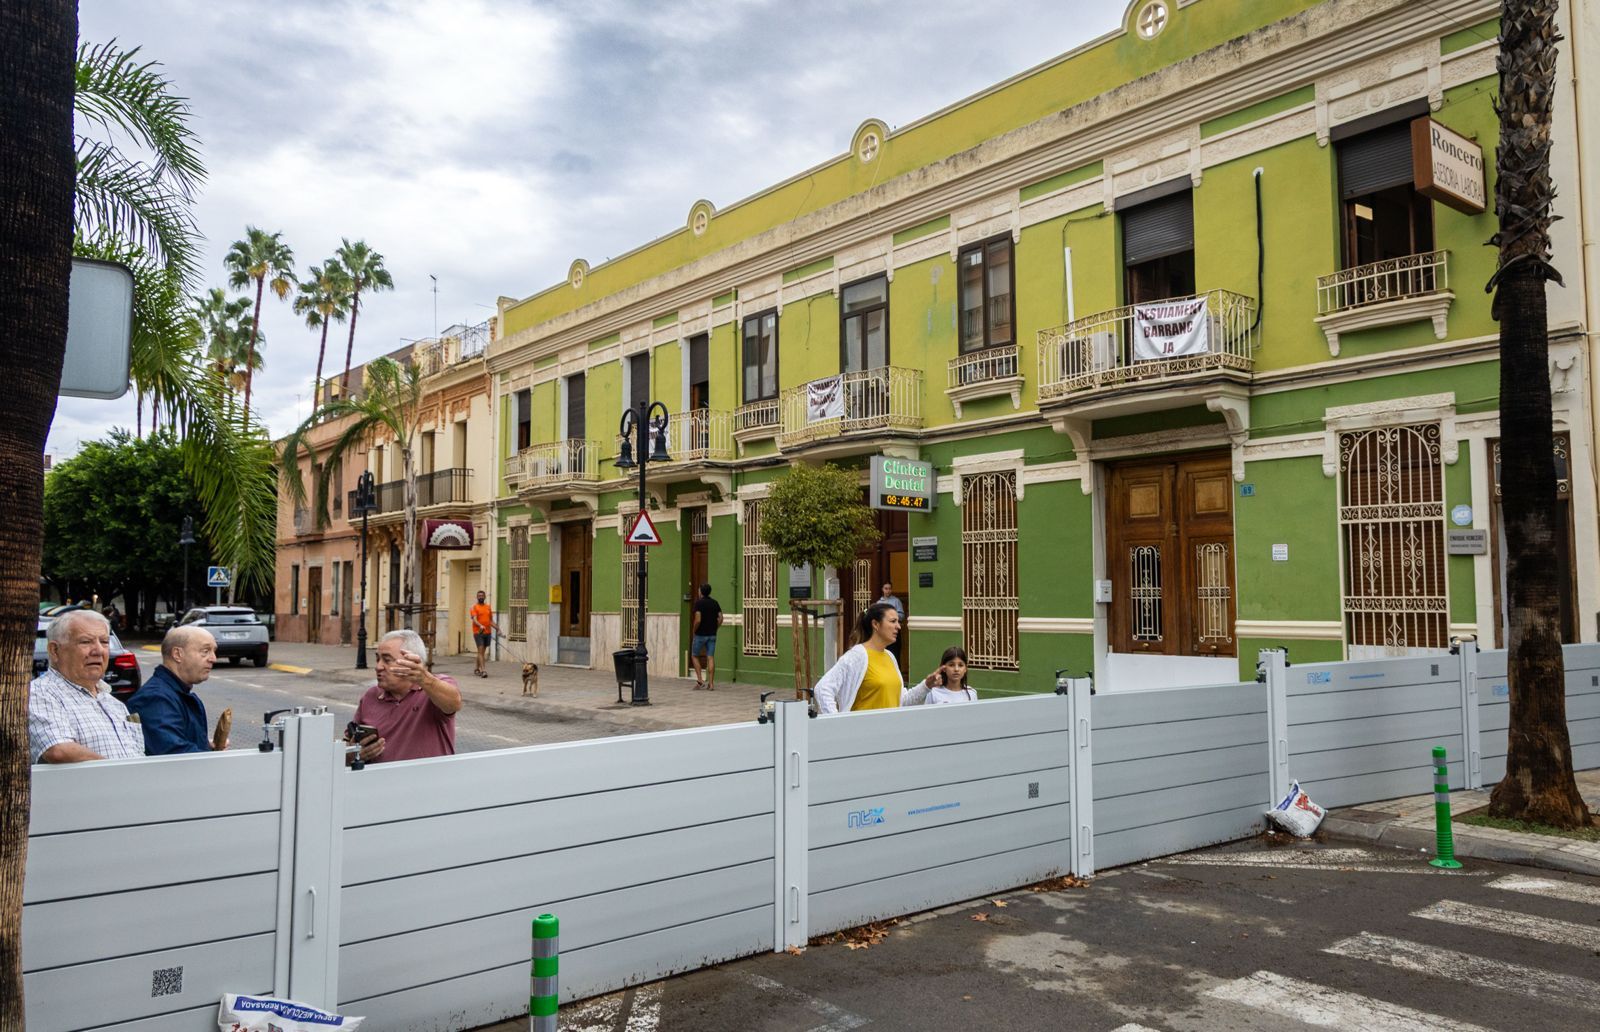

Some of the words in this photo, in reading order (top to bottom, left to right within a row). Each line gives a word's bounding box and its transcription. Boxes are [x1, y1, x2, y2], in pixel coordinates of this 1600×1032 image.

[1431, 127, 1482, 171] Roncero
[1143, 320, 1193, 338] BARRANC
[1162, 341, 1175, 354] JA
[885, 475, 925, 492] Dental
[241, 1000, 278, 1010] REPASADA
